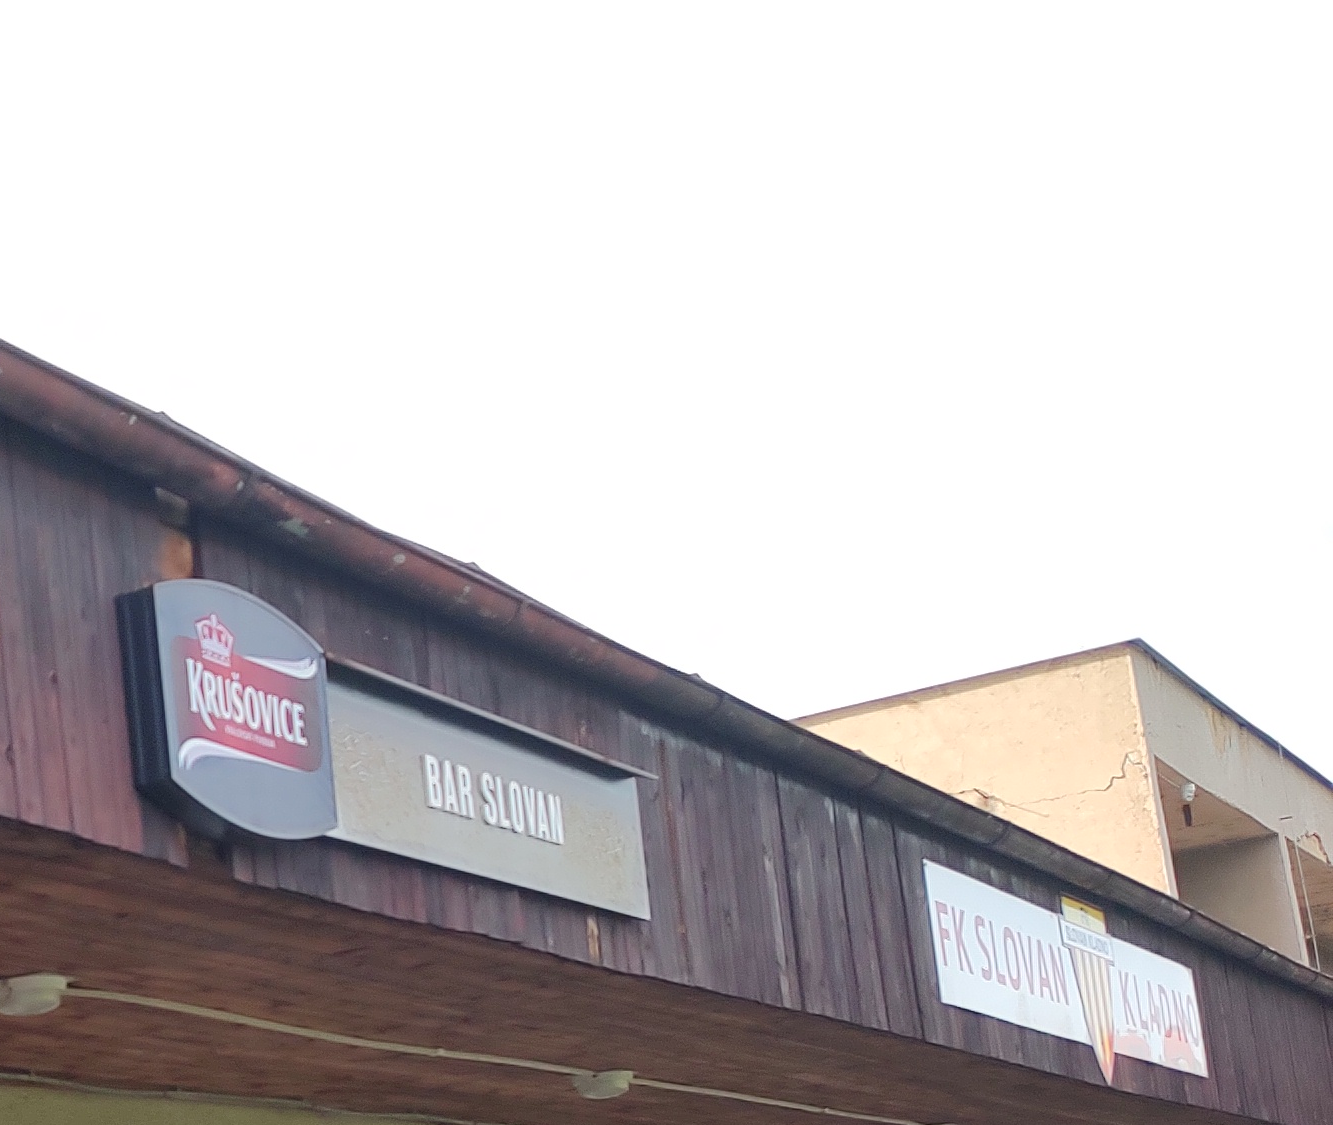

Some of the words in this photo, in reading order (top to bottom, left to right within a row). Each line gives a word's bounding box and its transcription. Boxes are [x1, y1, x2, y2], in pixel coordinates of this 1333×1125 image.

[185, 657, 309, 747] KRUŠOVICE
[421, 753, 476, 819] BAR
[480, 771, 565, 846] SLOVAN
[935, 900, 974, 975] FK
[974, 914, 1070, 1006] SLOVAN
[1118, 969, 1201, 1048] KLADNO
